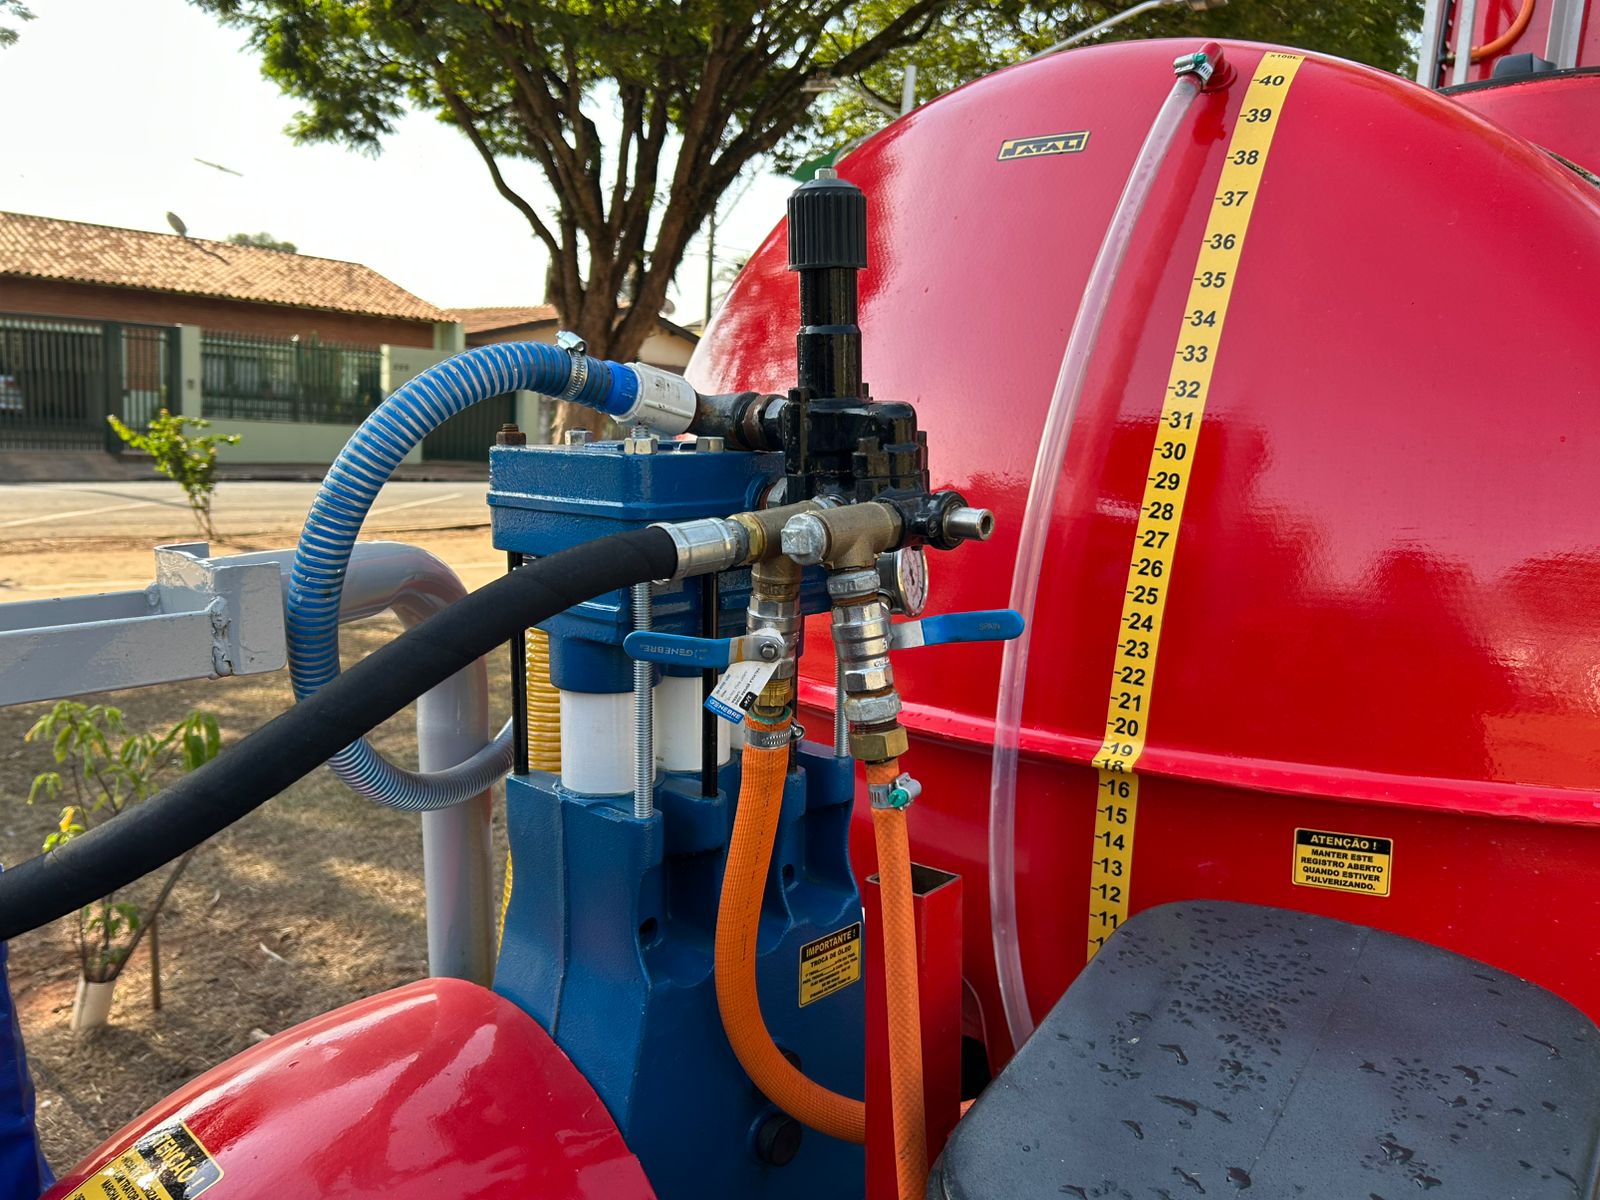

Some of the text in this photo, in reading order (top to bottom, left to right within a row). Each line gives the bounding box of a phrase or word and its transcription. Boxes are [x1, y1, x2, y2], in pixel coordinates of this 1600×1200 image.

[643, 643, 694, 658] GENEBRE
[709, 699, 741, 720] GENEBRE
[1310, 834, 1369, 849] ATENÇÃO
[1311, 848, 1374, 863] MANTER ESTE
[1300, 856, 1383, 873] REGISTRO ABERTO
[1302, 865, 1380, 882] QUANDO ESTIVER
[1305, 875, 1376, 891] PULVERIZANDO.
[806, 930, 852, 958] IMPORTANTE
[811, 955, 828, 968] TROCA
[829, 951, 837, 960] DE
